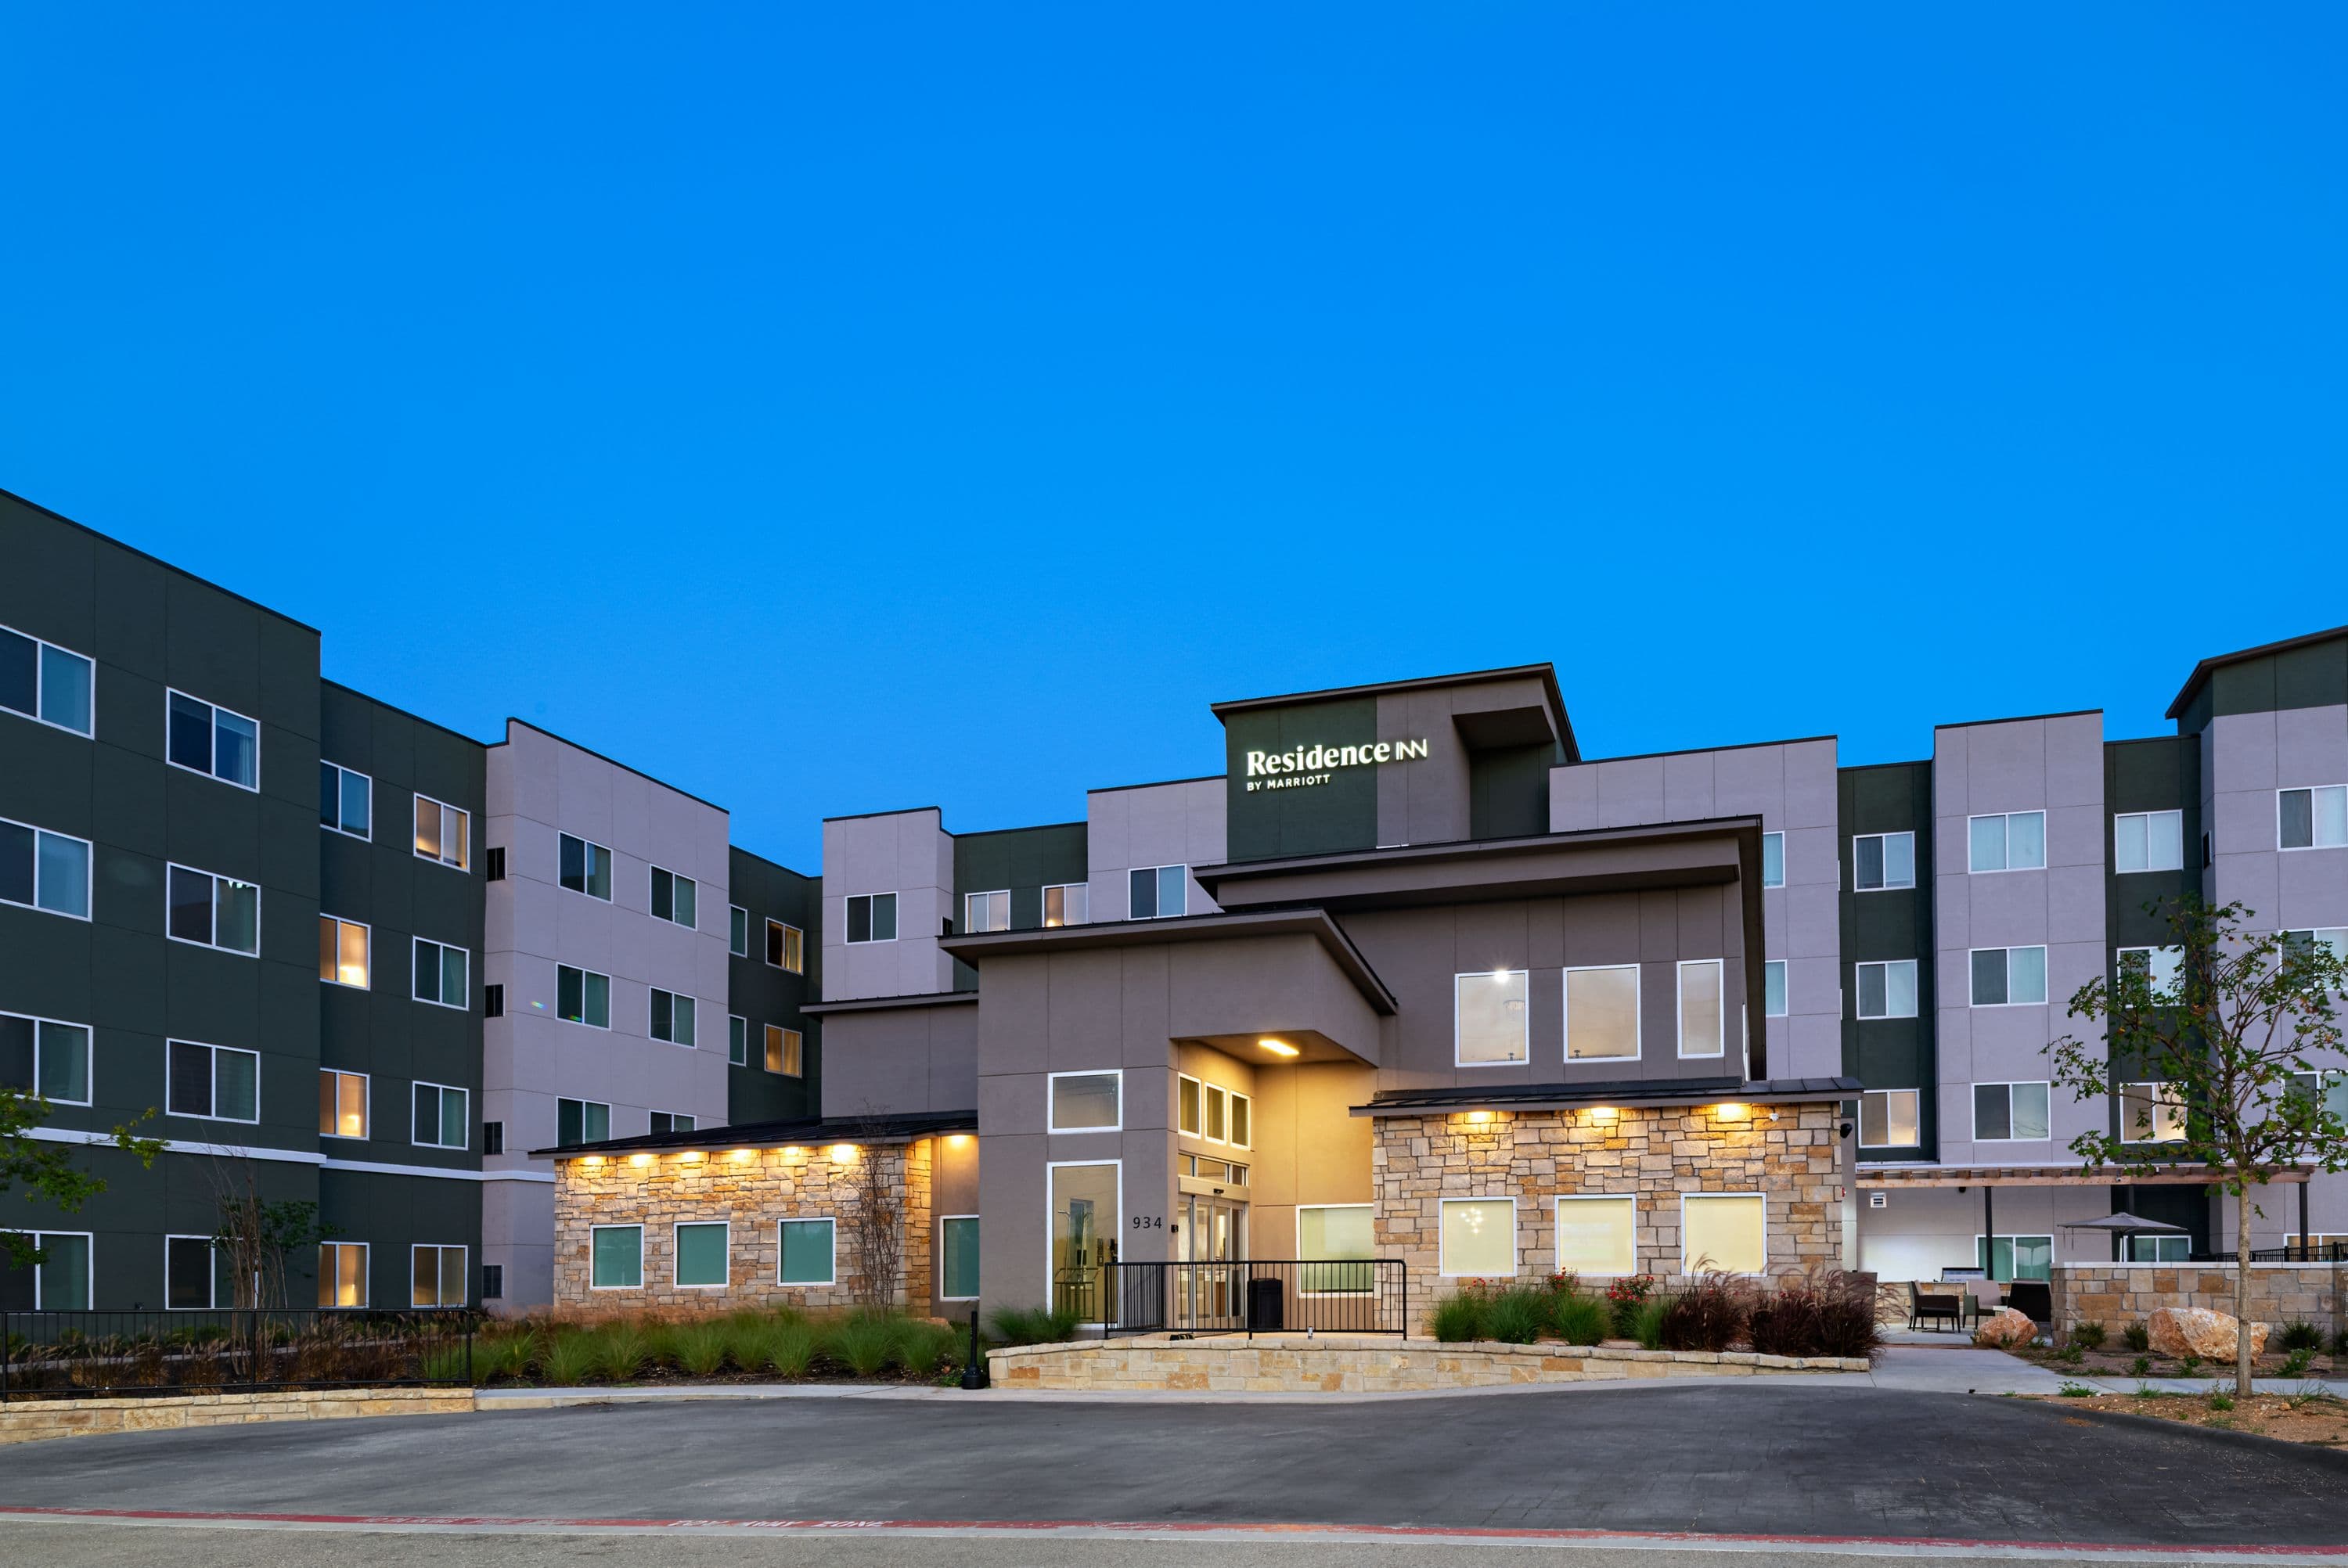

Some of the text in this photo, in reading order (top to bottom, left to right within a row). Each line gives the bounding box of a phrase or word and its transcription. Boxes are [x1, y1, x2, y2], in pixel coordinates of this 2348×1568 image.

[1247, 739, 1428, 776] Residence INN
[1247, 774, 1331, 792] BY MARRIOTT
[1133, 1216, 1162, 1229] 934
